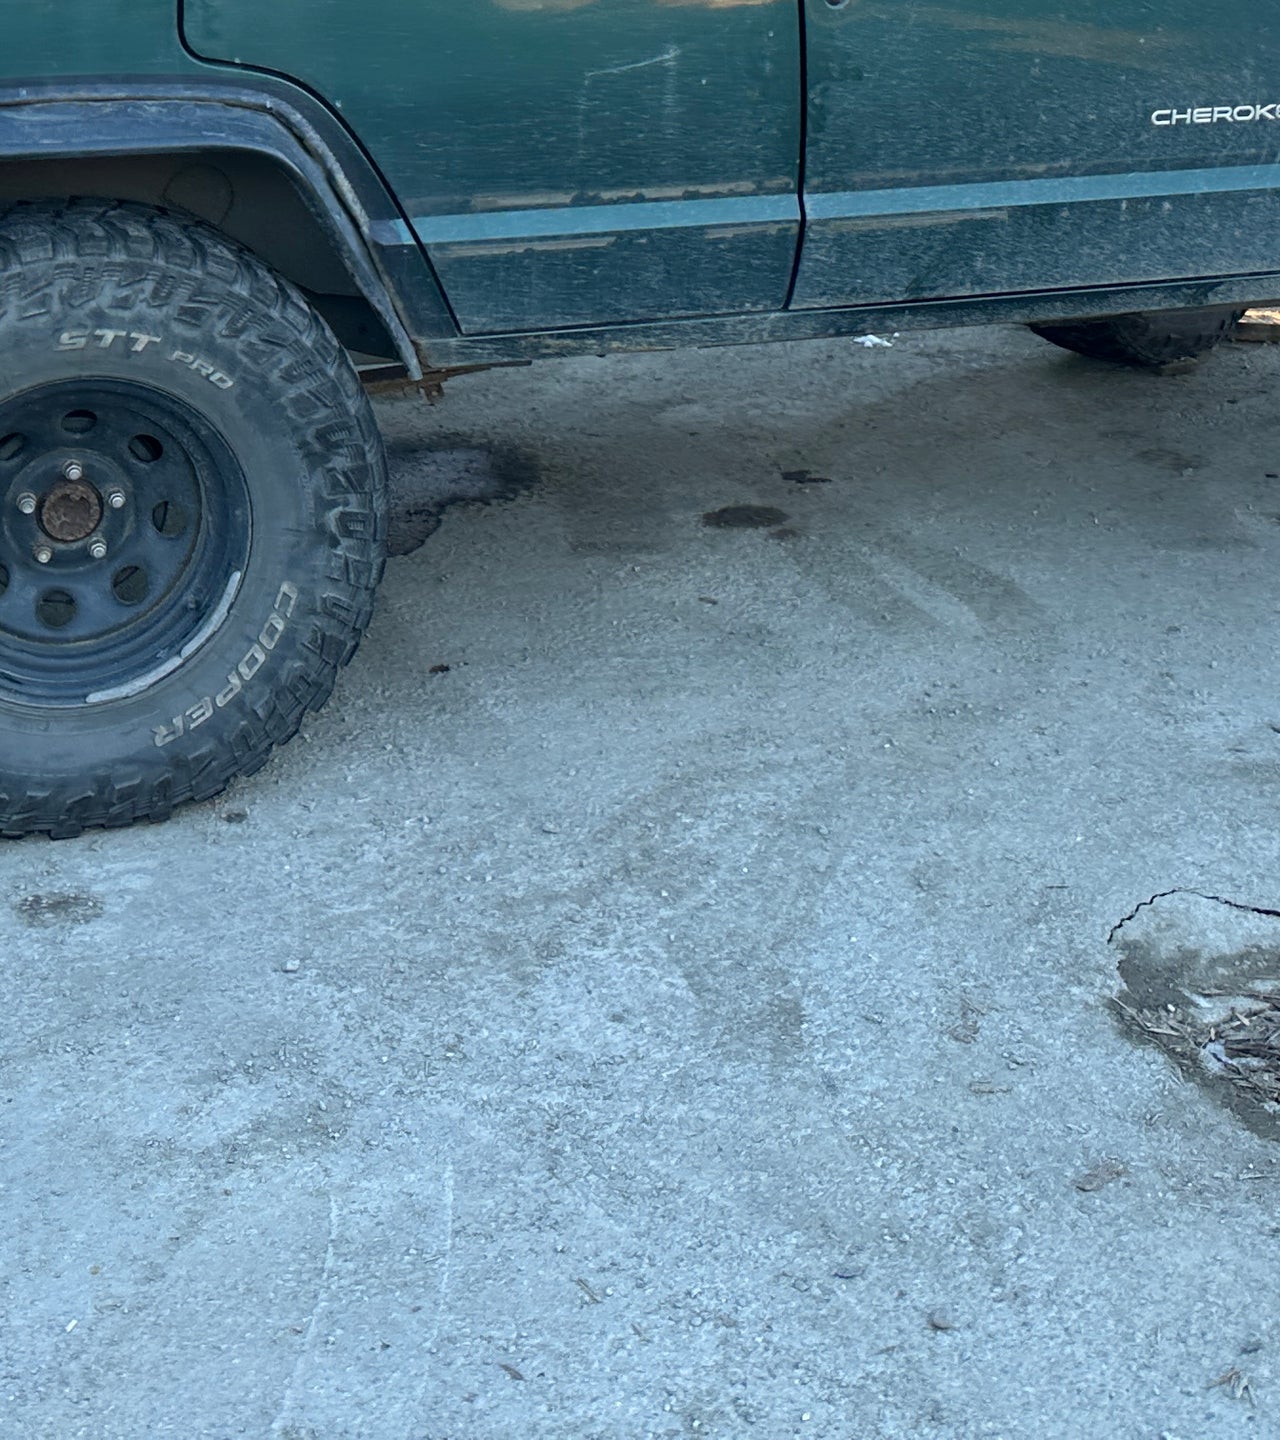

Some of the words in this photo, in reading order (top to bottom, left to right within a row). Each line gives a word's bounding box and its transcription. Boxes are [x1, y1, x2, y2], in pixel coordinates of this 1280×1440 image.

[53, 328, 162, 353] STT
[172, 350, 235, 390] PRO
[151, 580, 299, 748] COOPER
